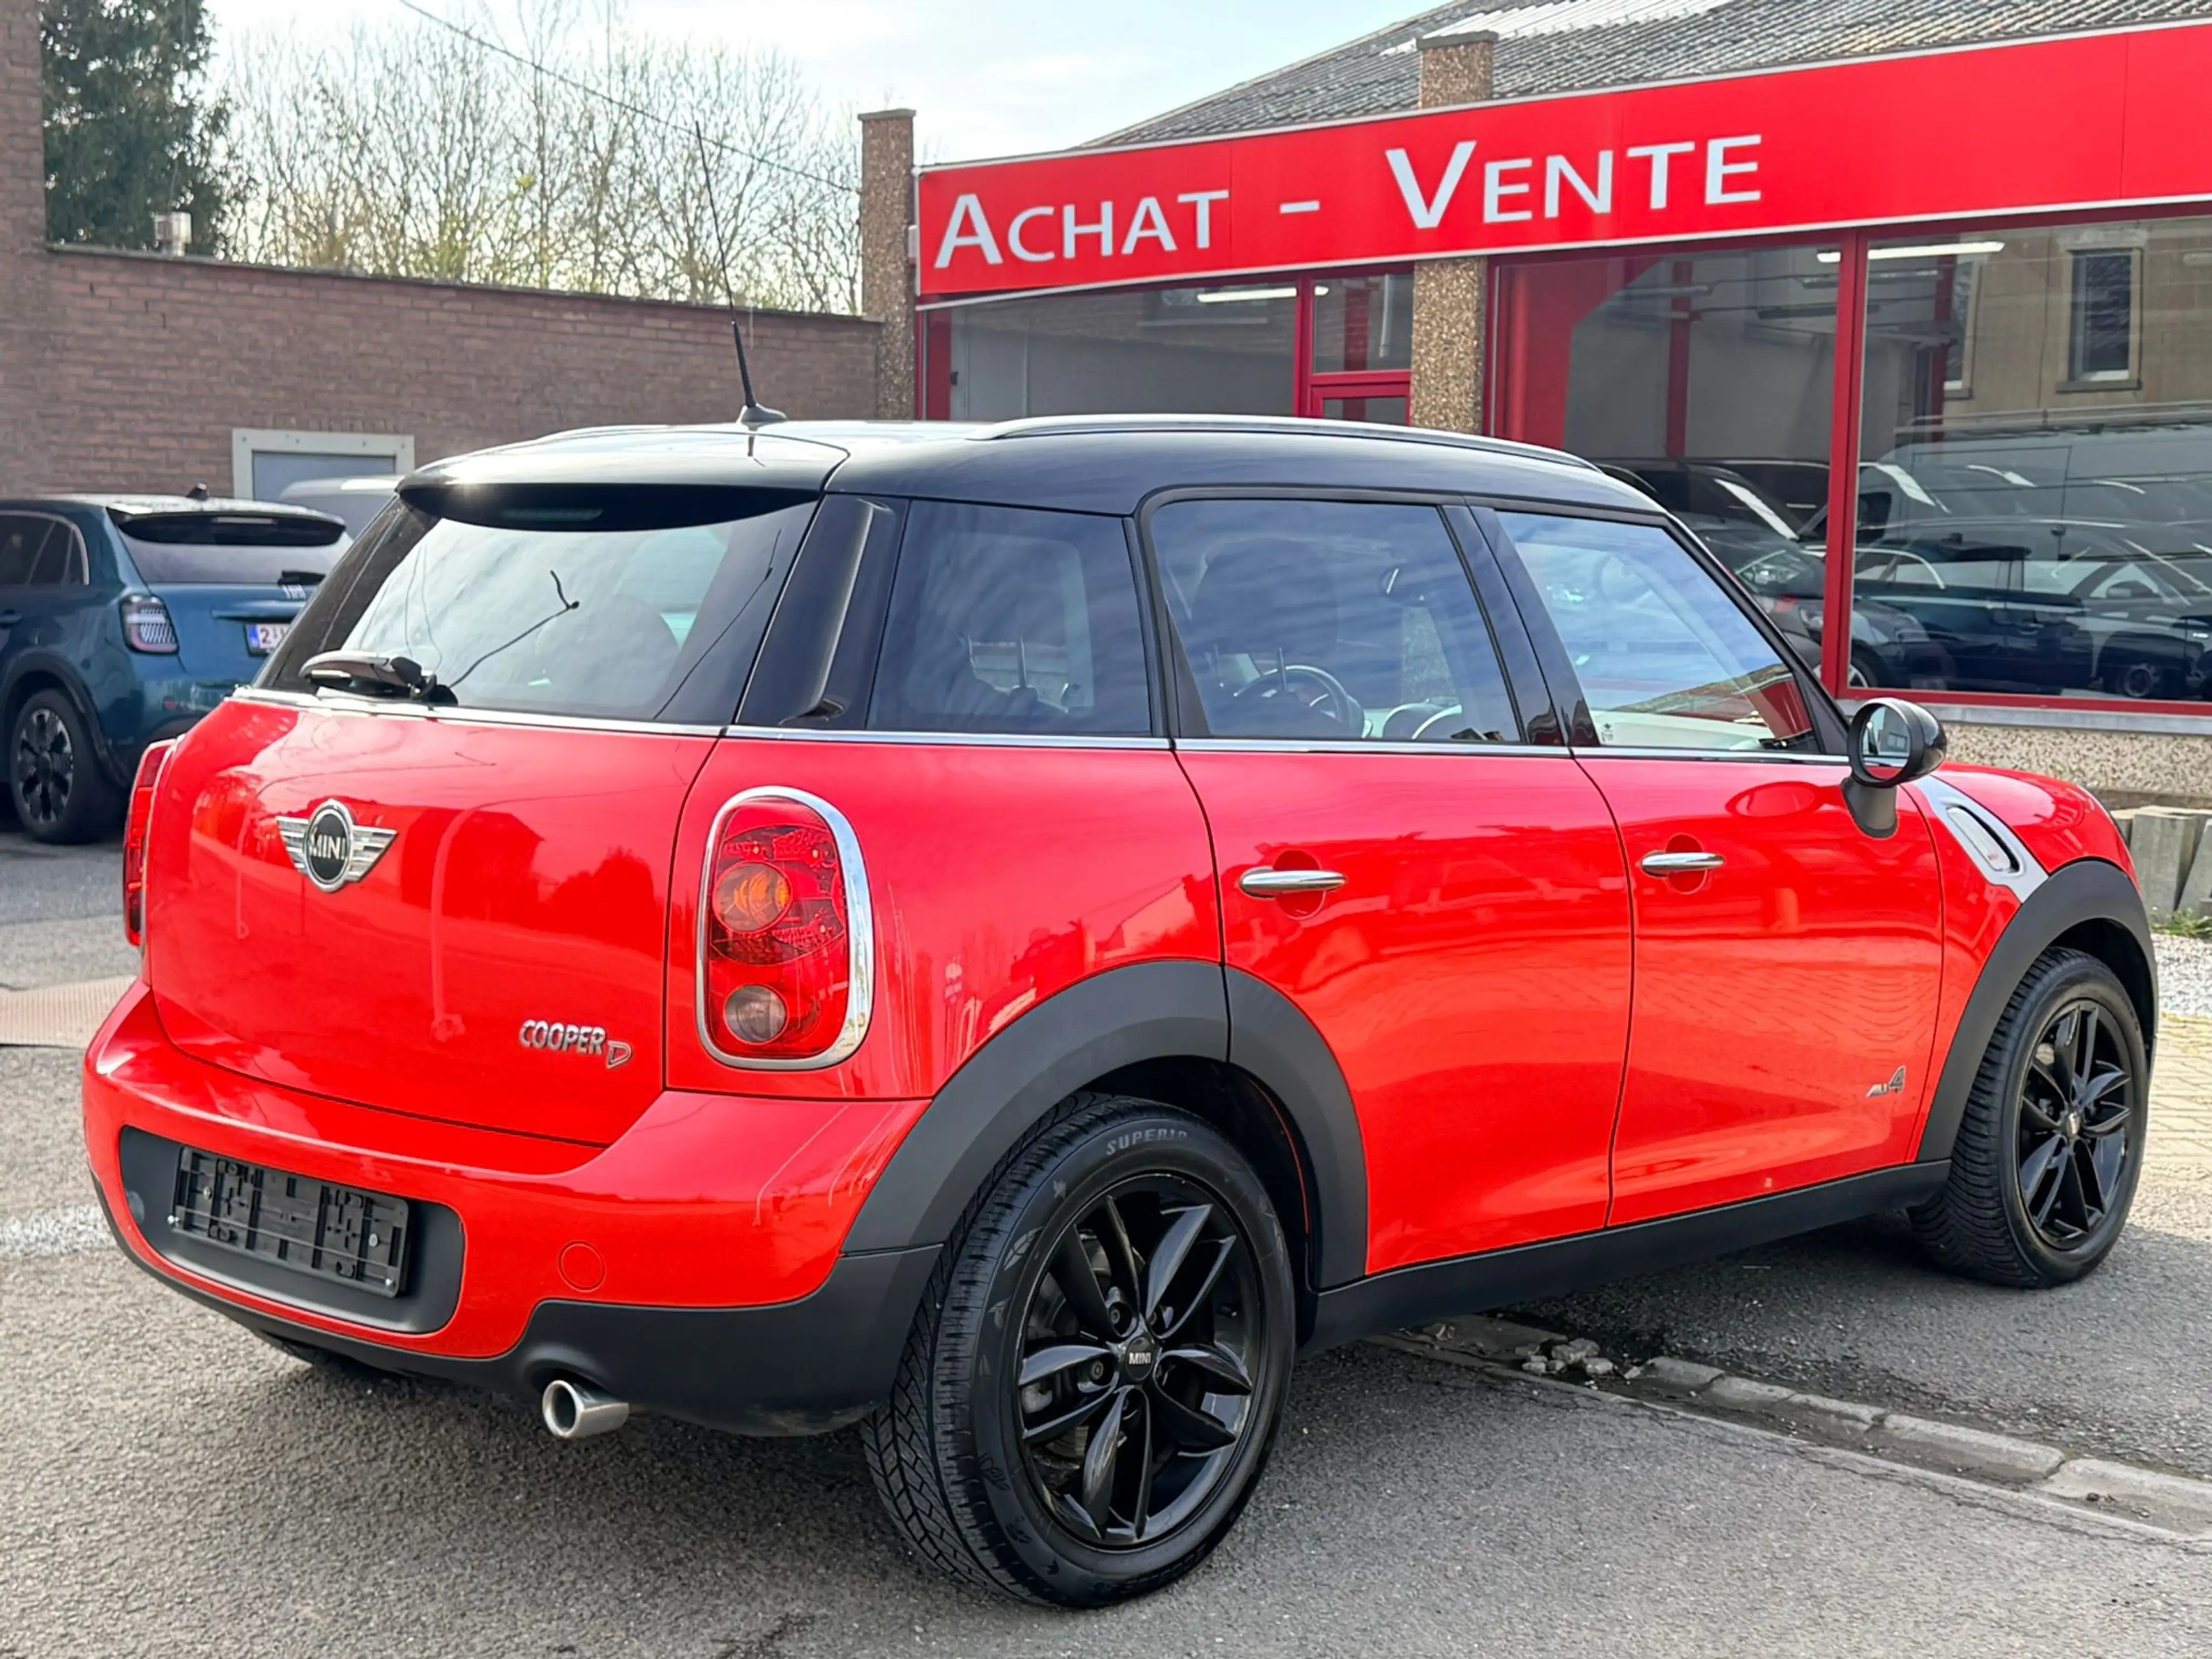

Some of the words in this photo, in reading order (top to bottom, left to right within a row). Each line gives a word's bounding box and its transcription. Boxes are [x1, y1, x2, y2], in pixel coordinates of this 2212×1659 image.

[520, 1019, 606, 1055] COOPER
[606, 1040, 632, 1069] D
[1129, 1352, 1152, 1365] MINI
